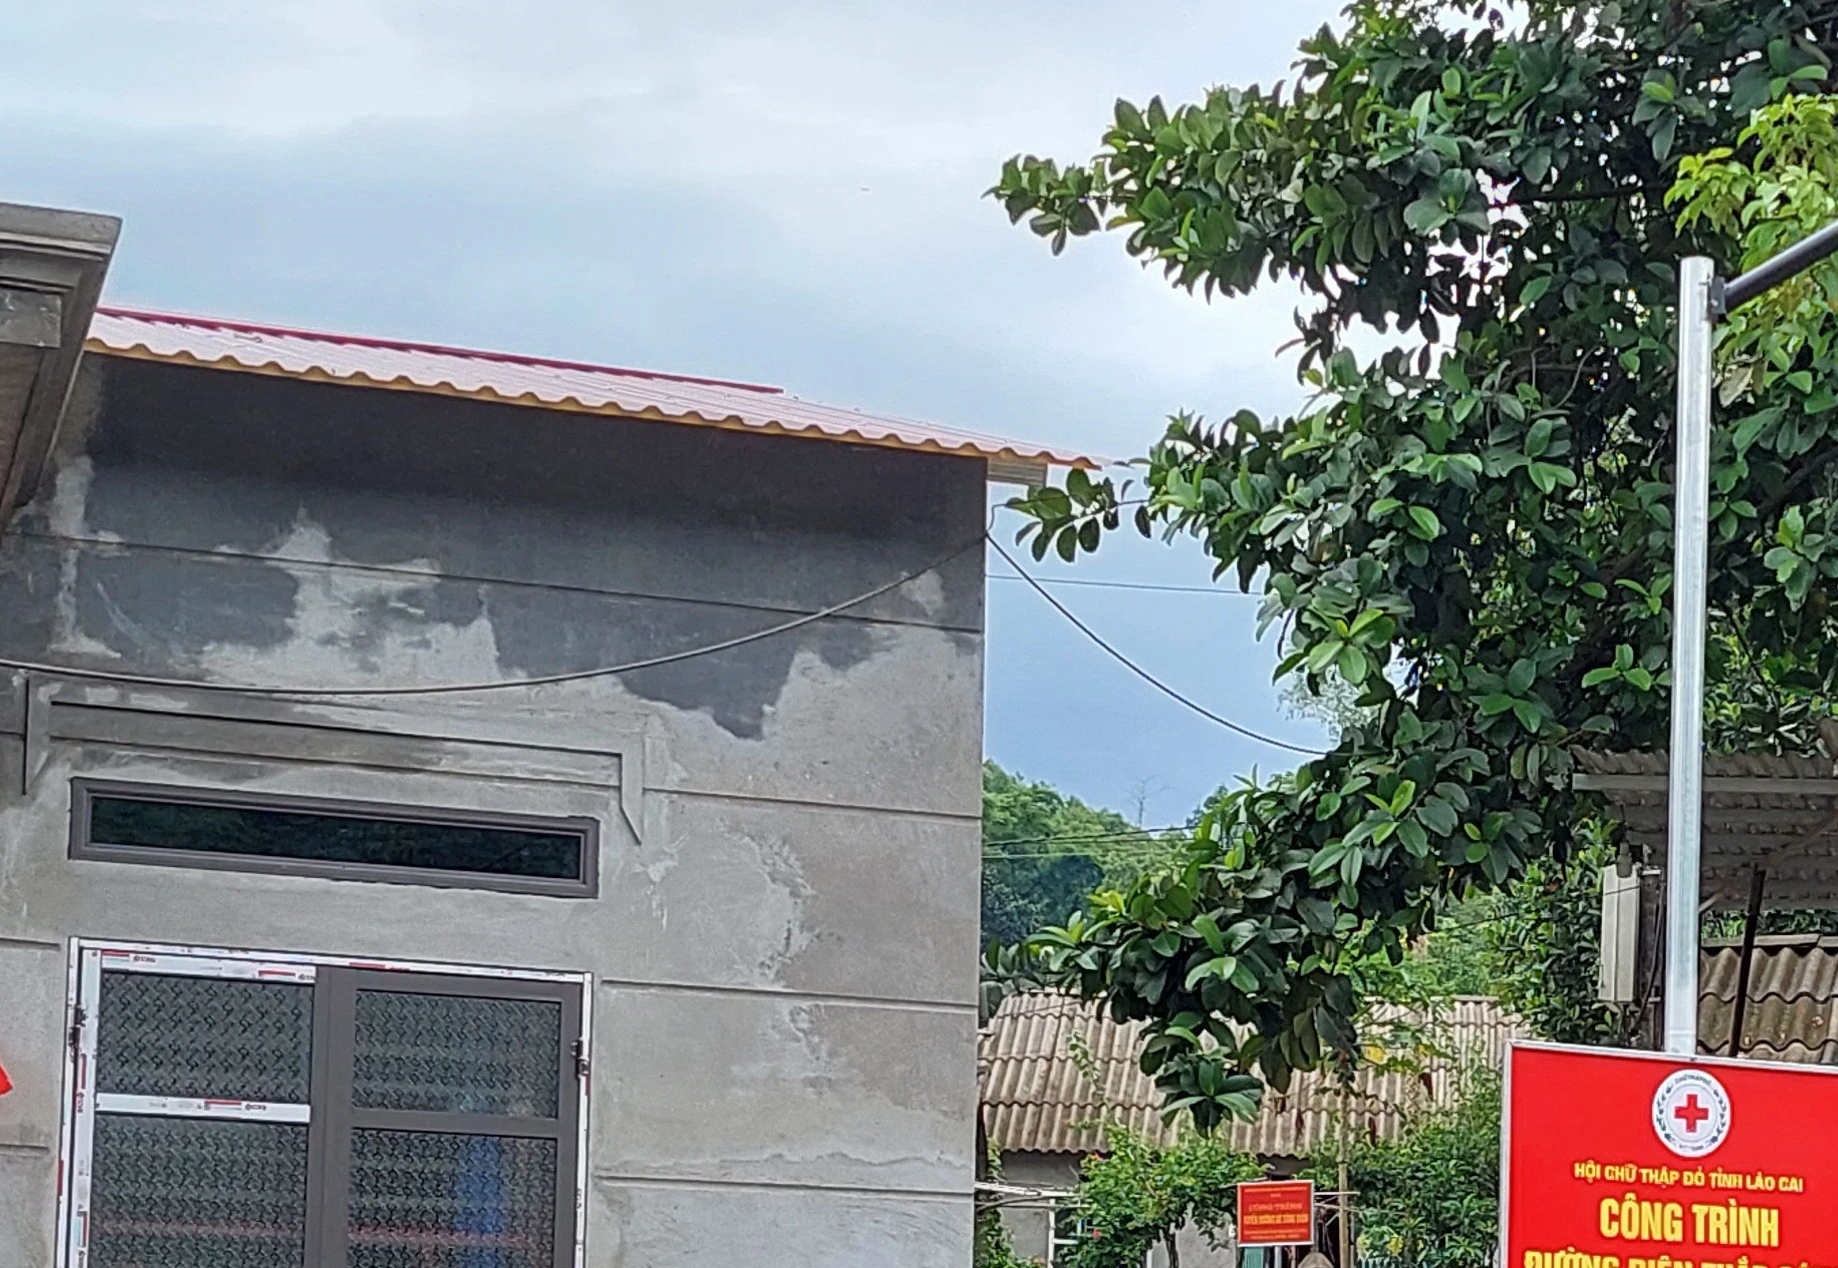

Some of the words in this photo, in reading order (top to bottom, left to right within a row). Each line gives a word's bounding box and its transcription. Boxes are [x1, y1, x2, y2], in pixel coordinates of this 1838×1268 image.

[1574, 1161, 1601, 1183] HỘI
[1604, 1164, 1637, 1182] CHỮ
[1639, 1166, 1680, 1188] THẬP
[1682, 1165, 1706, 1186] ĐỎ
[1778, 1176, 1804, 1193] CAI
[1600, 1192, 1683, 1242] CÔNG
[1691, 1198, 1779, 1247] TRÌNH
